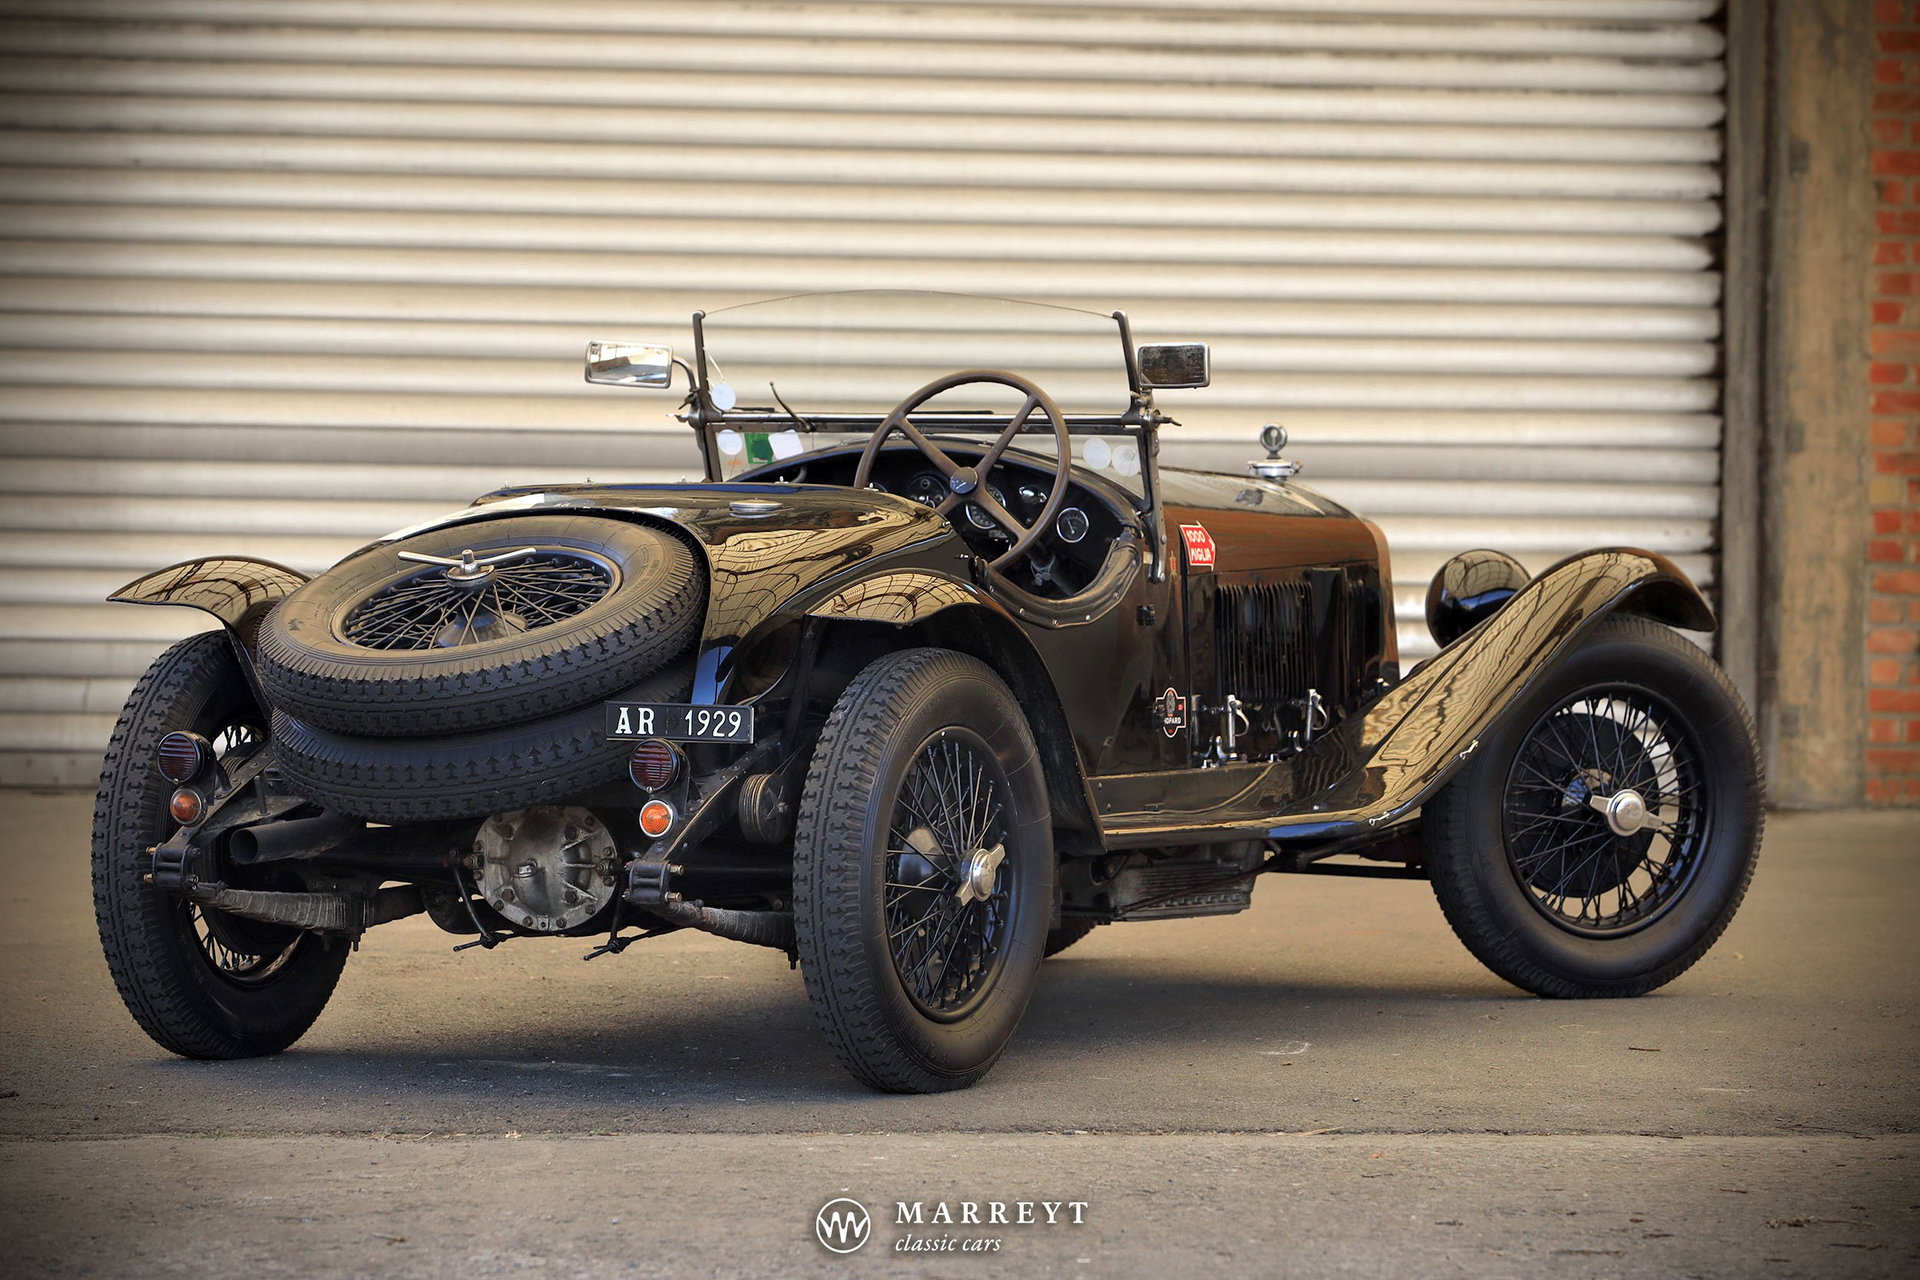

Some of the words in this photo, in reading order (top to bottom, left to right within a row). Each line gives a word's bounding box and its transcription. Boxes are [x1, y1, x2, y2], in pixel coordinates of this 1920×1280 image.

[1186, 530, 1206, 543] 1000
[615, 707, 654, 735] AR
[684, 709, 742, 737] 1929
